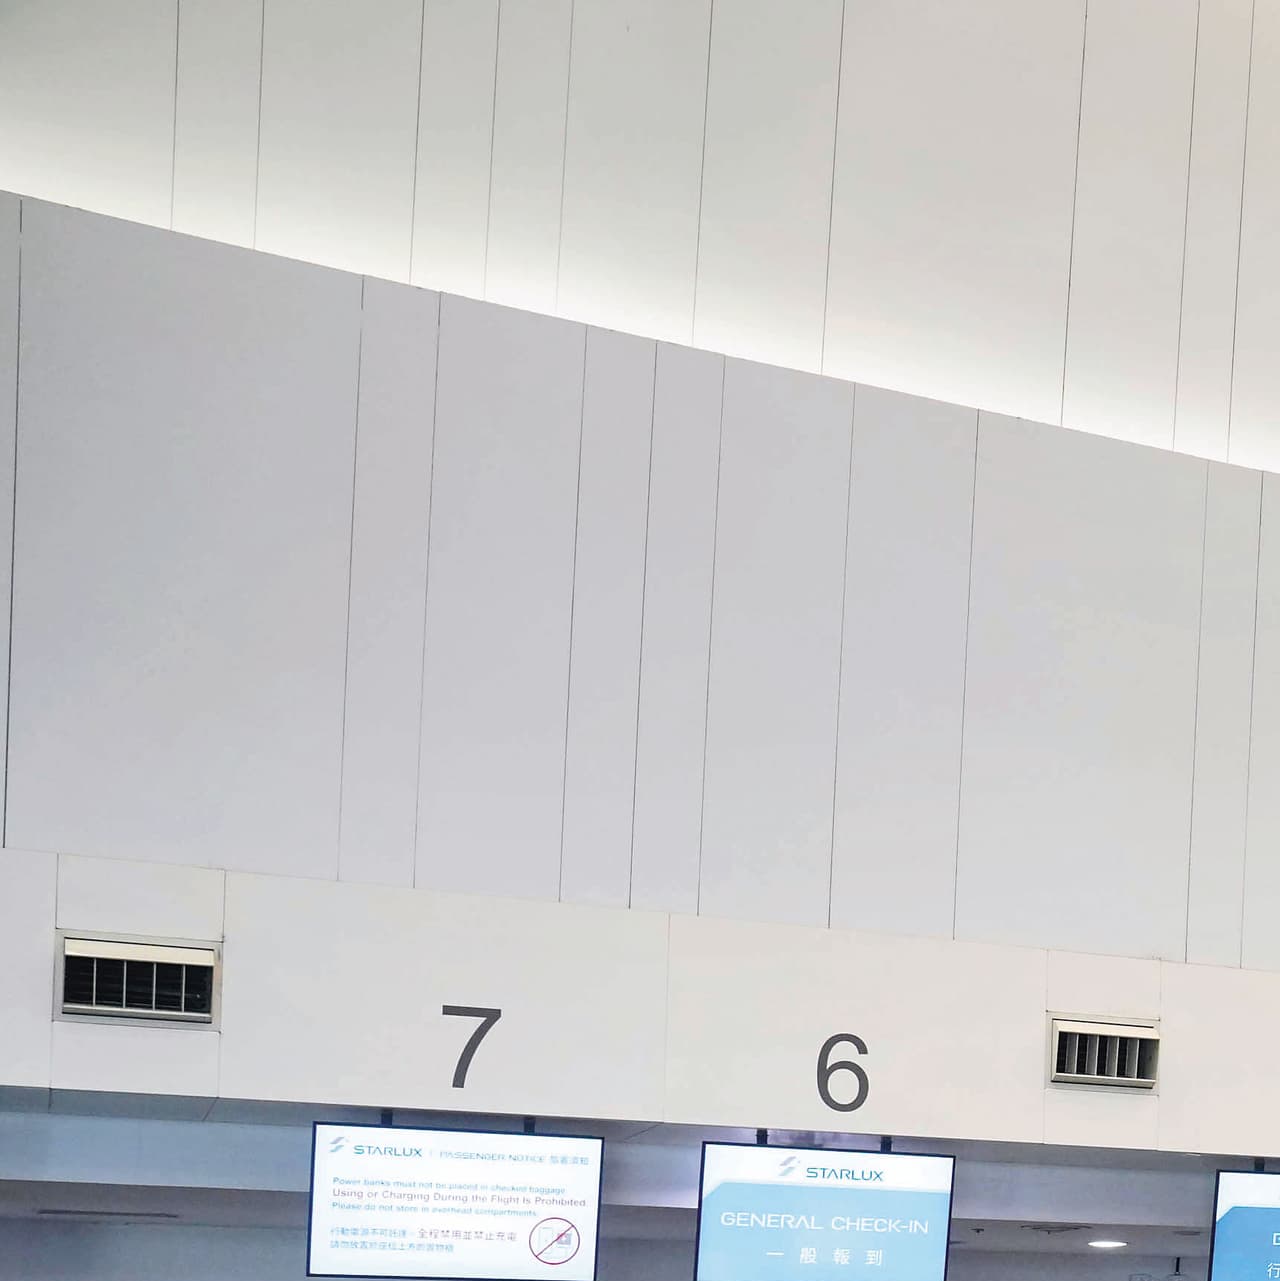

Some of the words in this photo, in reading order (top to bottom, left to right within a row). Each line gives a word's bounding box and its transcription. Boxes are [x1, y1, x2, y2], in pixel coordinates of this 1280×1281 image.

[442, 1005, 501, 1088] 7
[817, 1033, 869, 1112] 6
[353, 1145, 422, 1157] STARLUX
[440, 1151, 505, 1161] PASSENGER
[508, 1154, 545, 1163] NOTICE
[333, 1177, 361, 1185] Power
[363, 1178, 391, 1187] banks
[806, 1167, 884, 1182] STARLUX
[333, 1188, 364, 1200] Using
[382, 1190, 430, 1203] Charging
[433, 1192, 468, 1204] During
[471, 1194, 487, 1202] the
[491, 1195, 520, 1206] Flight
[332, 1202, 361, 1211] Please
[364, 1203, 376, 1211] do
[378, 1204, 393, 1212] not
[720, 1212, 824, 1230] GENERAL
[831, 1216, 929, 1234] CHECK-IN
[766, 1248, 882, 1266] 一般報到
